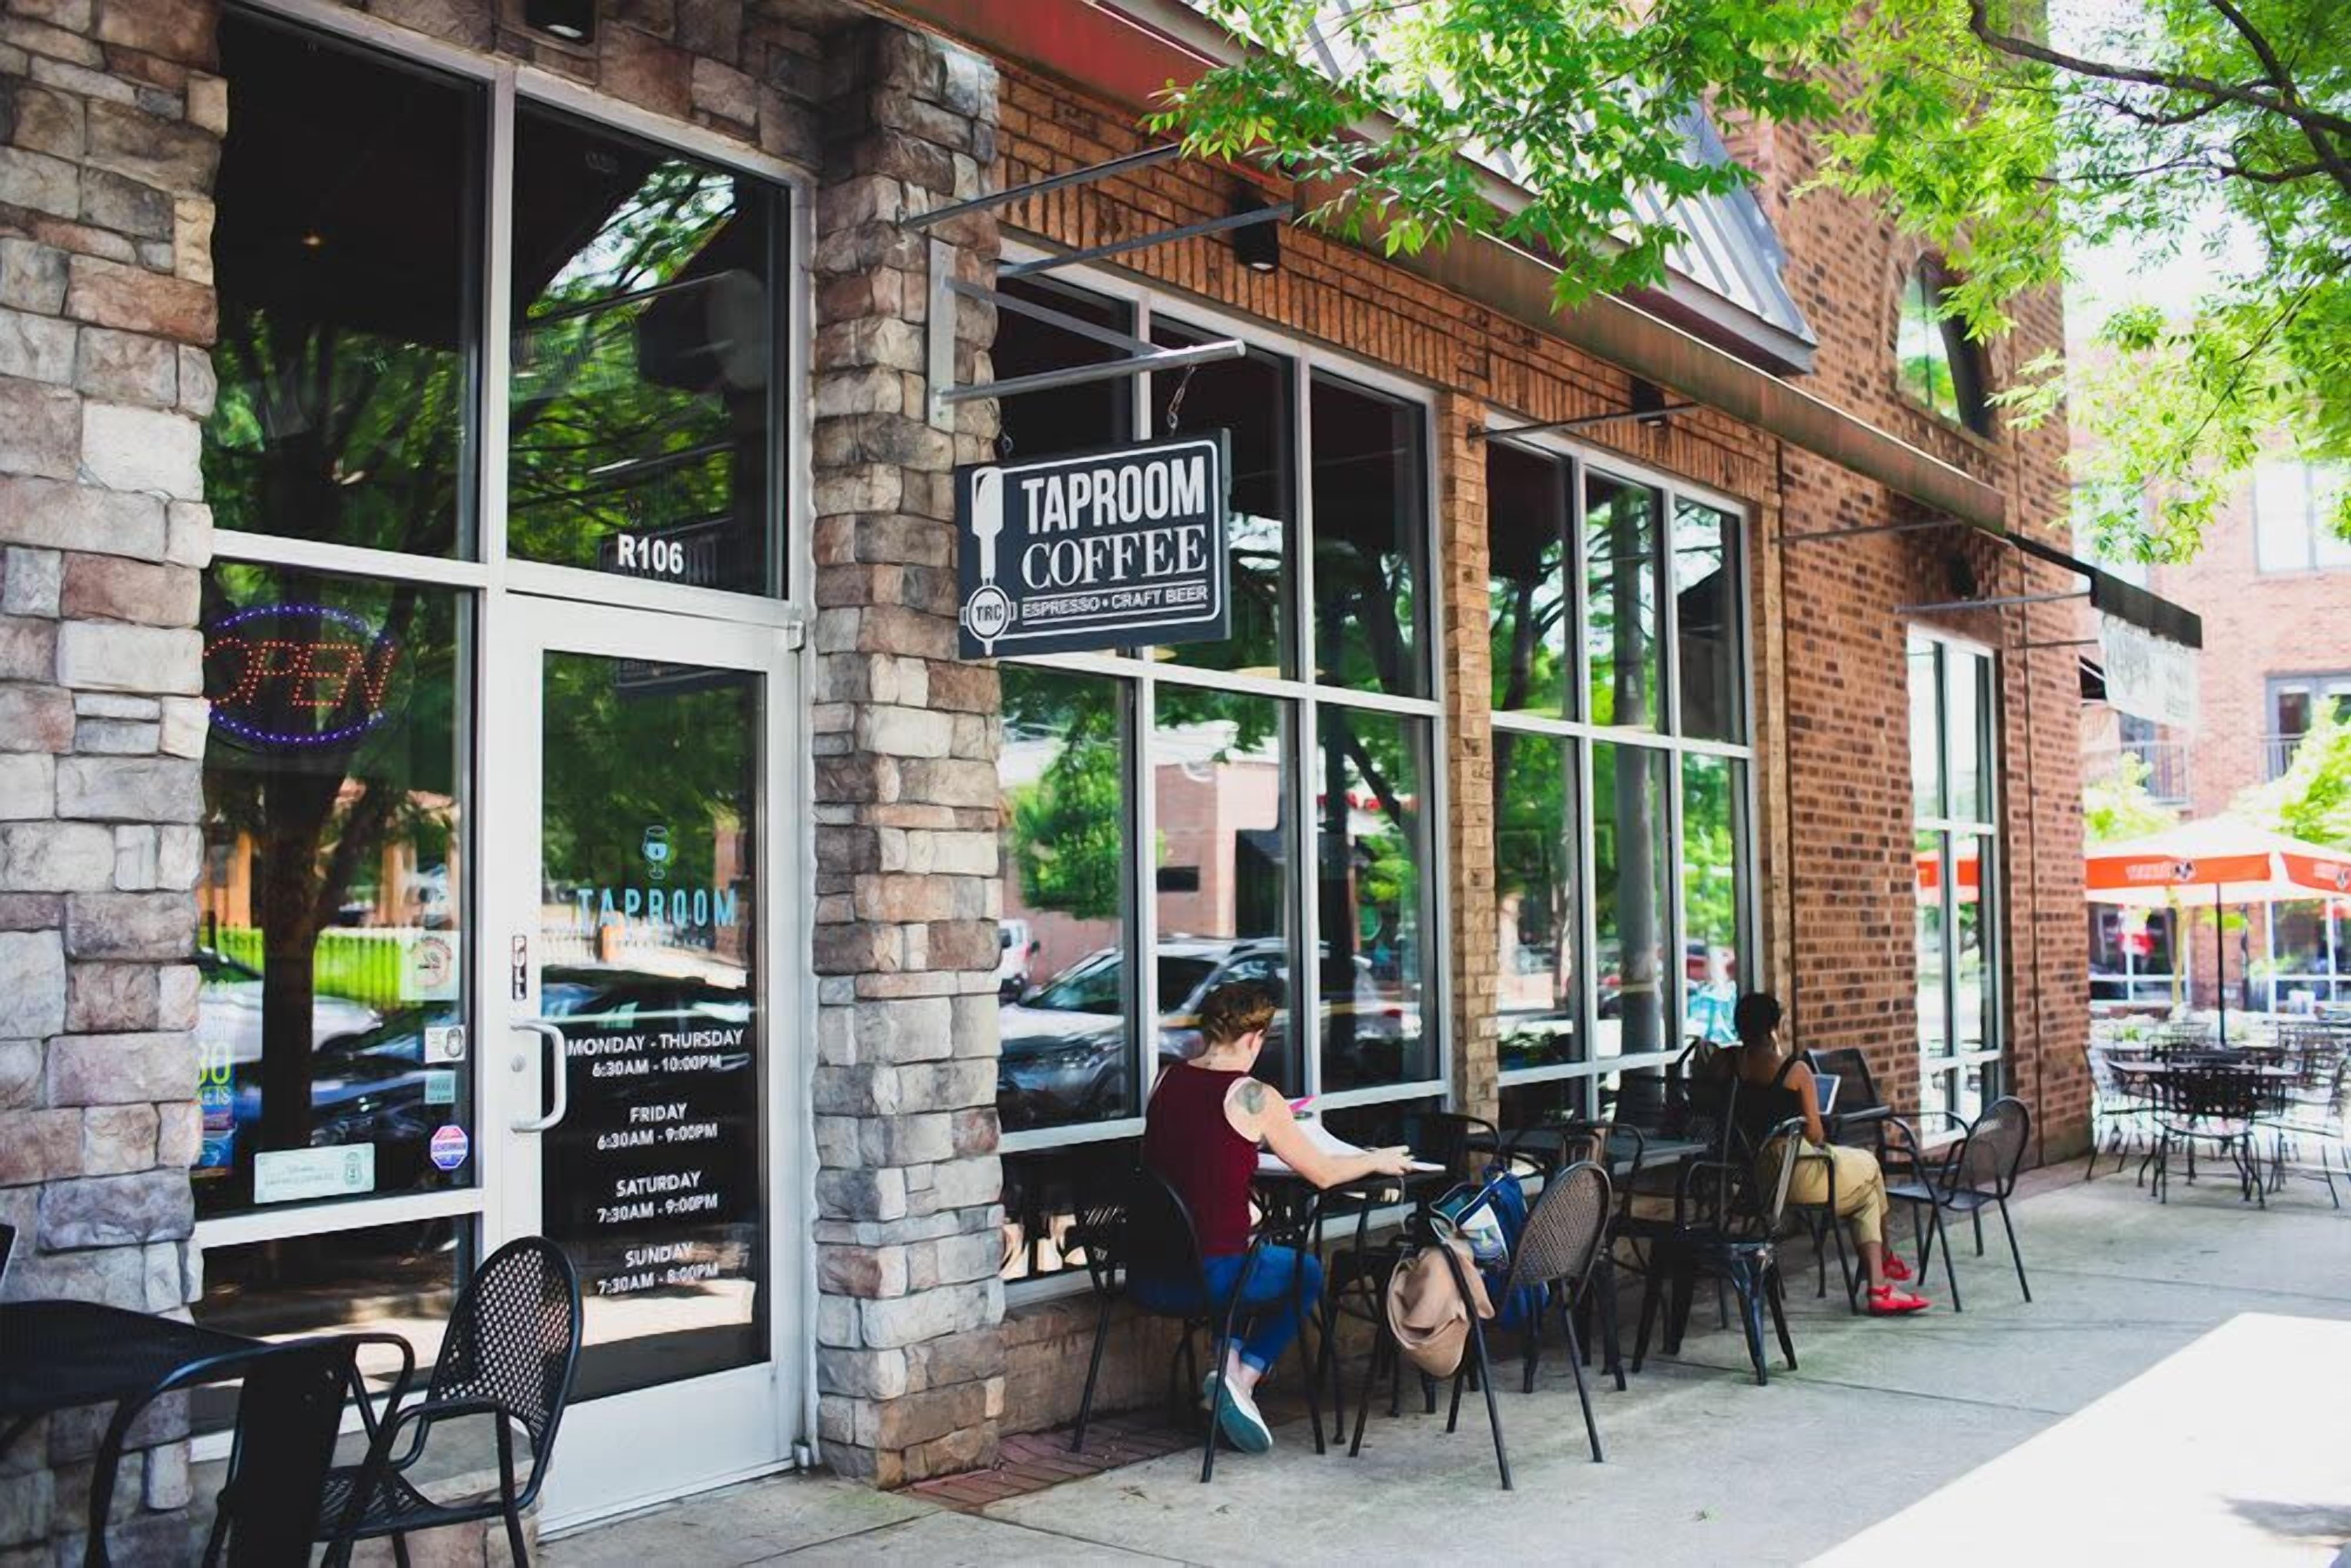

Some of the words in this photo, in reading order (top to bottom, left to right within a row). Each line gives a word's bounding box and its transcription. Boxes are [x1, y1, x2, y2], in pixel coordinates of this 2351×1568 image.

[1022, 456, 1204, 534] TAPROOM
[618, 534, 684, 574] R106
[1022, 524, 1207, 589] COFFEE
[1023, 597, 1100, 618] ESPRESSO
[1112, 589, 1161, 609] CRAFT
[1166, 586, 1208, 604] BEER
[202, 636, 396, 707] OPEN
[577, 887, 737, 928] TAPROOM
[567, 1035, 645, 1056] MONDAY
[658, 1029, 744, 1049] THURSDAY
[592, 1058, 649, 1077] 6:30AM
[661, 1054, 722, 1073] 10:00PM
[629, 1102, 687, 1123] FRIDAY
[597, 1129, 654, 1150] 6:30AM
[616, 1170, 701, 1197] SATURDAY
[597, 1202, 654, 1222] 7:30AM
[625, 1241, 694, 1268] SUNDAY
[597, 1272, 654, 1295] 7:30AM
